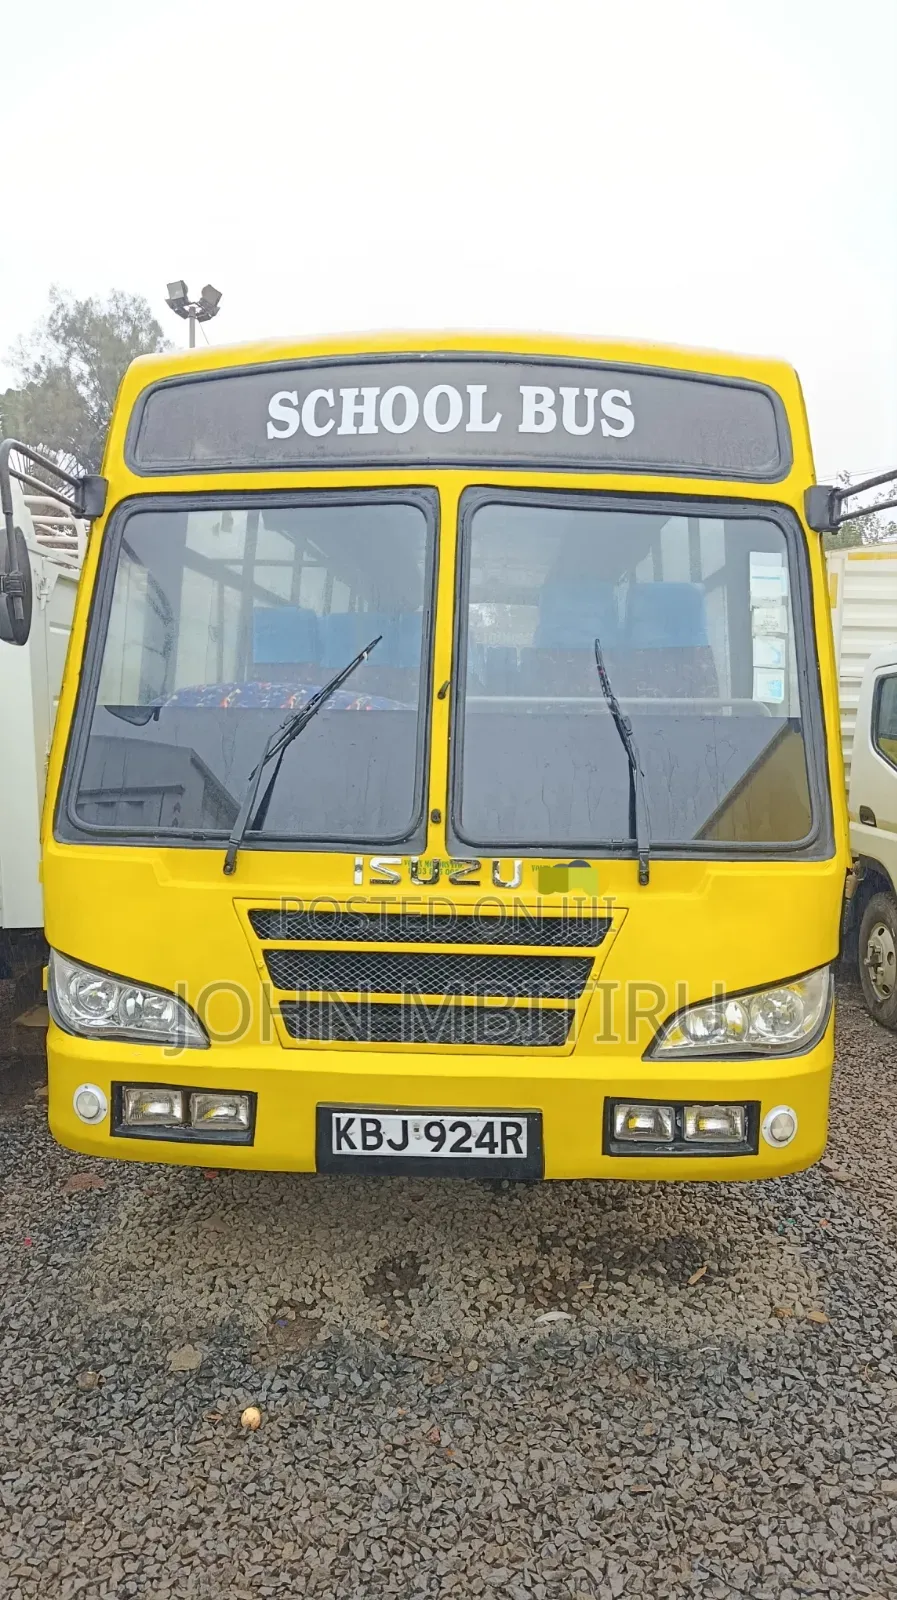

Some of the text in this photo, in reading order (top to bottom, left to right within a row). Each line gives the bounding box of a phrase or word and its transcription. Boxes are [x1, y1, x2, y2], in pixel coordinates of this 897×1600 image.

[266, 384, 635, 440] SCHOOL BUS
[353, 856, 522, 888] ISUZU
[335, 1117, 523, 1155] KBJ 924R
